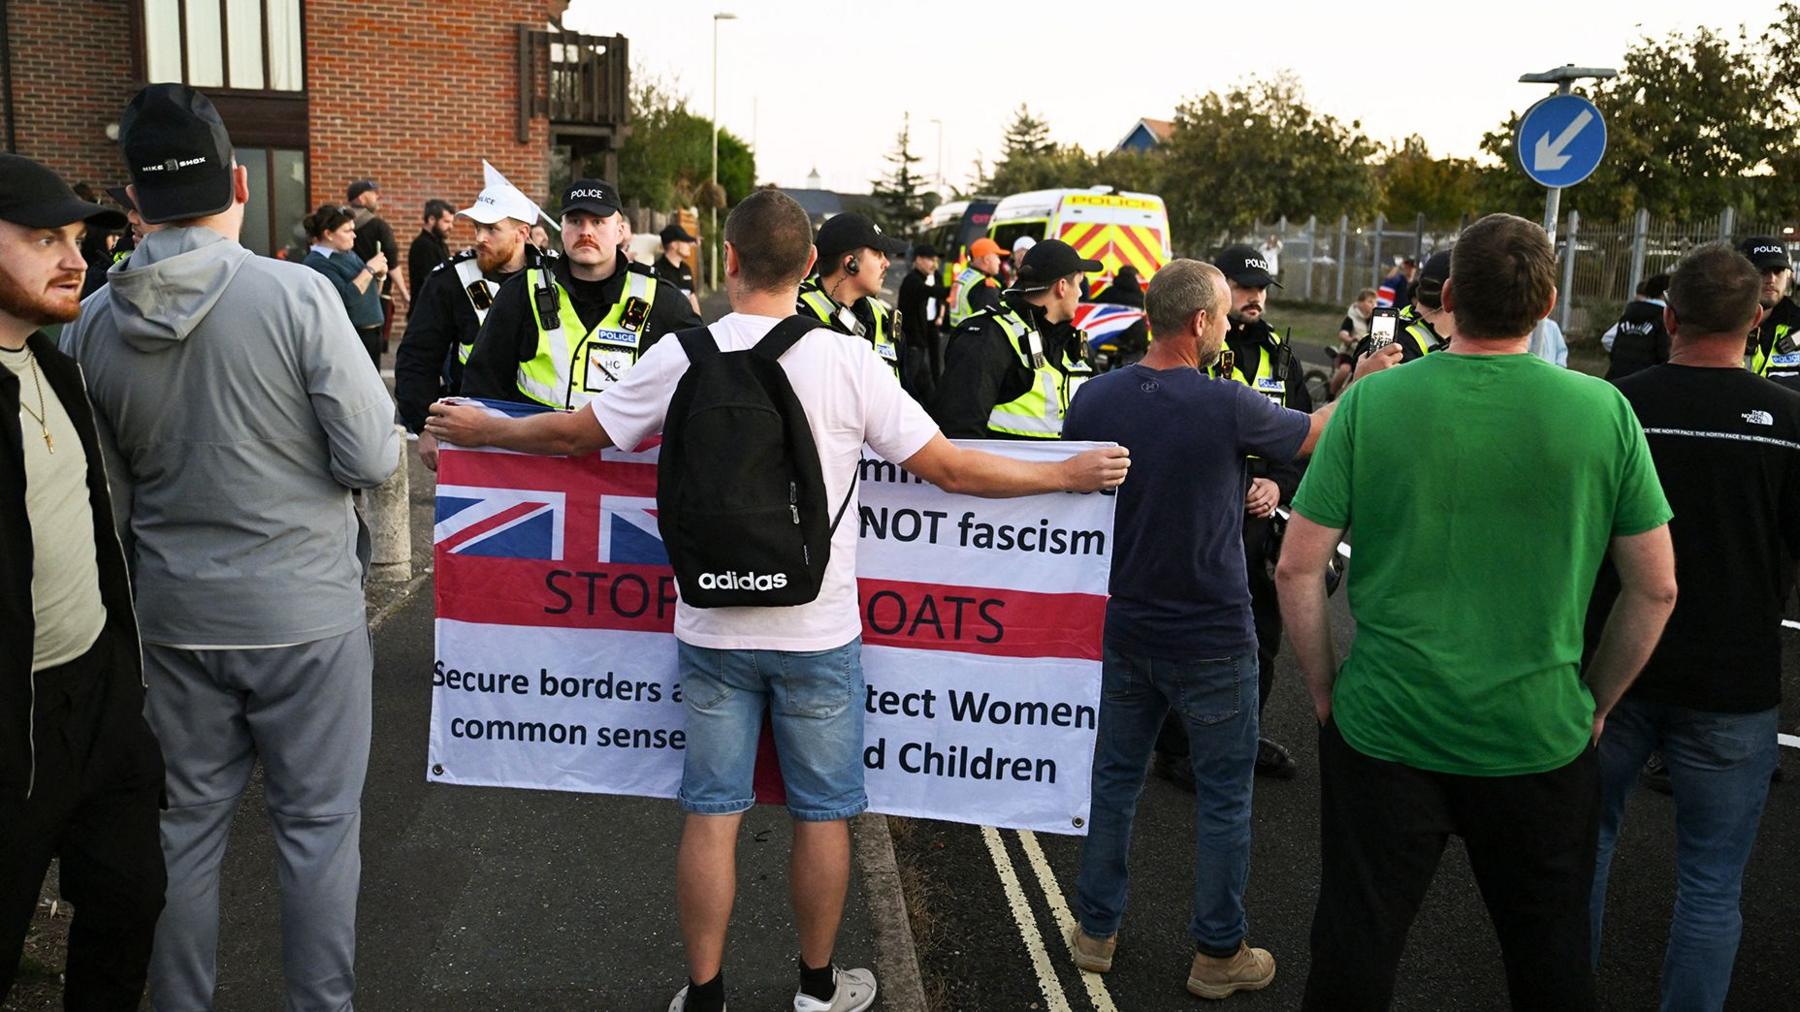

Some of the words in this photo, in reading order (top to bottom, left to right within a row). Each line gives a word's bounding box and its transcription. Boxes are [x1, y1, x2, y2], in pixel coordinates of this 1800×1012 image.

[179, 157, 206, 167] SHOX
[570, 188, 603, 200] POLICE
[1072, 195, 1153, 209] POLICE
[600, 330, 635, 342] POLICE
[605, 360, 621, 370] HC
[859, 506, 948, 544] NOT
[958, 511, 1106, 556] fascism
[698, 570, 788, 591] adidas
[865, 590, 1005, 644] OATS
[433, 659, 529, 694] Secure
[540, 668, 662, 703] borders
[865, 684, 936, 719] tect
[948, 689, 1096, 730] Women
[450, 715, 588, 746] common
[596, 724, 686, 750] sense
[898, 741, 1057, 784] Children
